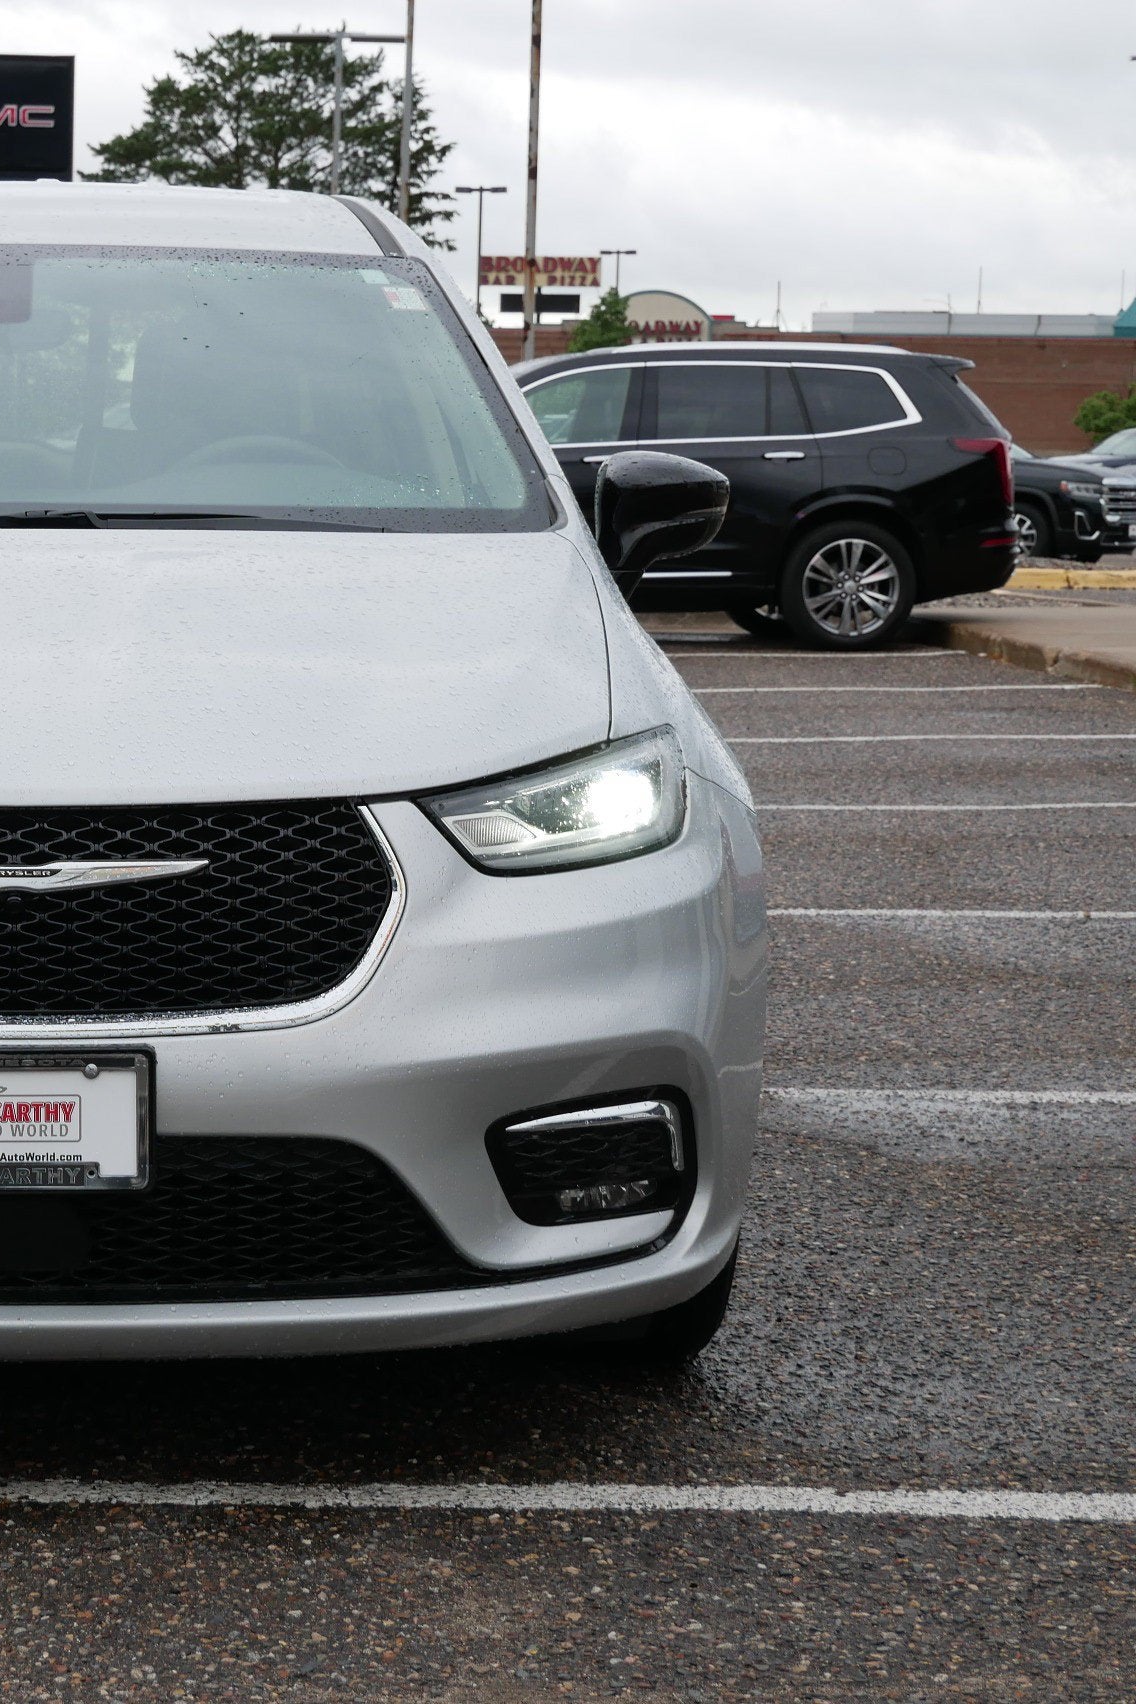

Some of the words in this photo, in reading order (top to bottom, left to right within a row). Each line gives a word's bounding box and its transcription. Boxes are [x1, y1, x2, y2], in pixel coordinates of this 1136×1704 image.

[480, 275, 516, 286] BAR
[547, 275, 601, 287] PIZZA
[627, 320, 702, 336] OADWAY
[10, 1124, 69, 1137] WORLD
